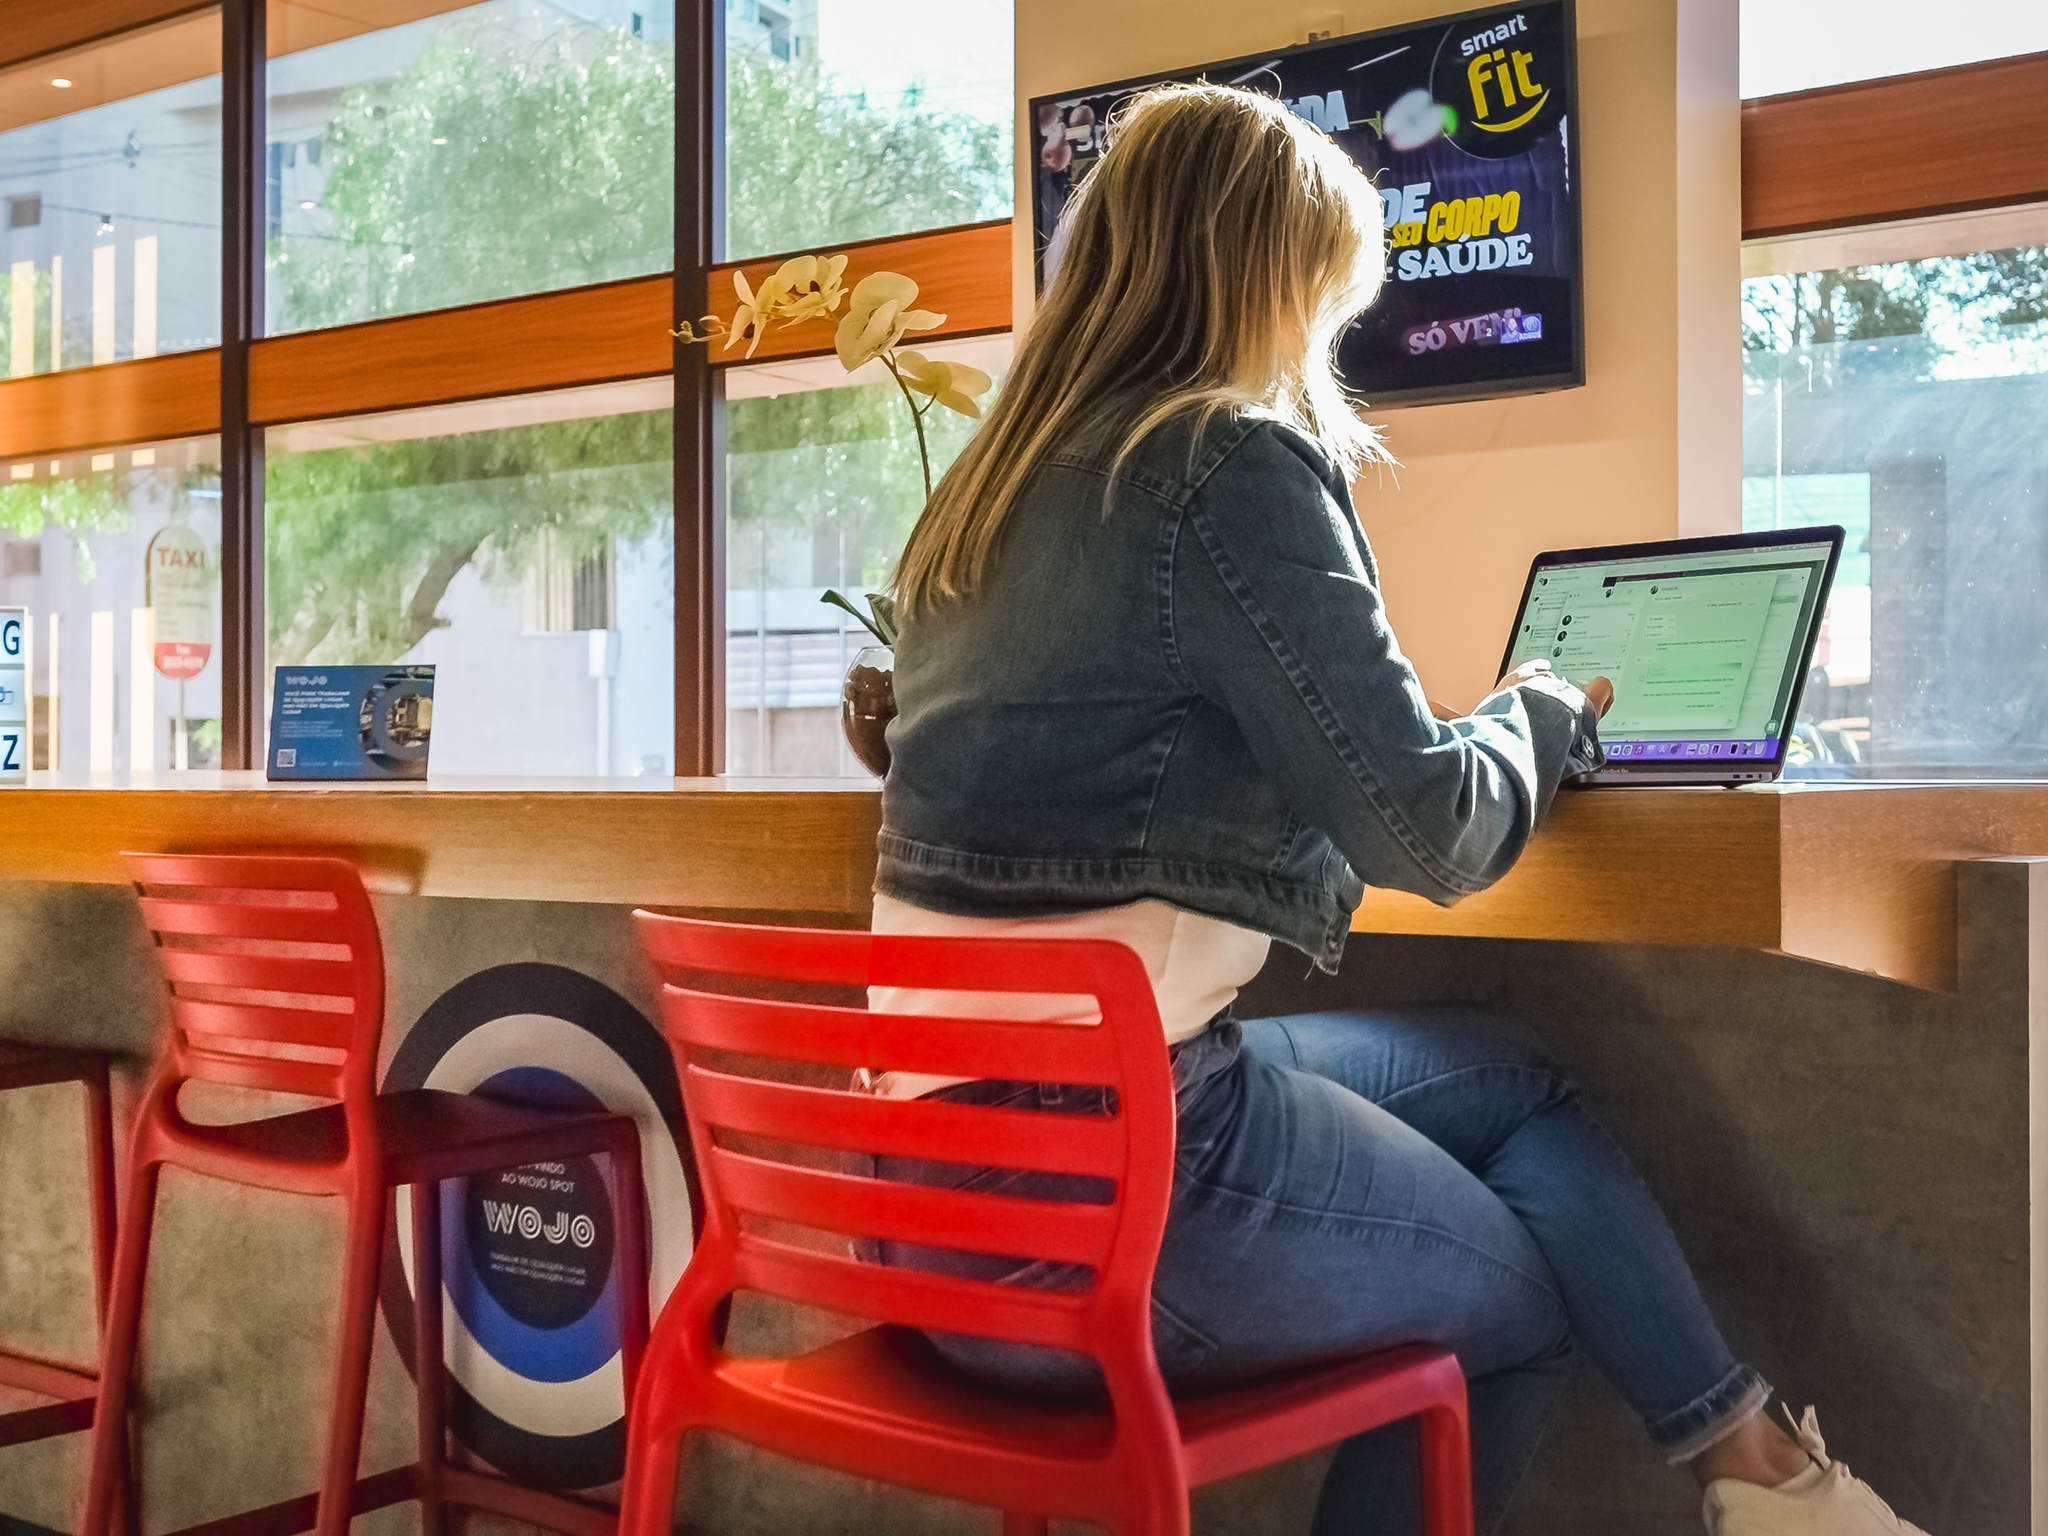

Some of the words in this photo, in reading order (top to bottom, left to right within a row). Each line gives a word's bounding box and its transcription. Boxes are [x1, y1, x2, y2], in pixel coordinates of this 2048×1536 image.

[1460, 14, 1528, 56] smart
[1467, 48, 1543, 120] fit
[1283, 90, 1350, 133] DA
[1426, 190, 1521, 243] CORPO
[1397, 233, 1534, 282] SAÚDE
[1408, 320, 1447, 356] SÓ
[156, 548, 205, 569] TAXI
[2, 619, 21, 656] G
[2, 734, 20, 771] Z
[501, 1172, 517, 1185] AO
[517, 1174, 549, 1190] WOJO
[549, 1178, 576, 1194] SPOT
[482, 1199, 596, 1249] WOJO
